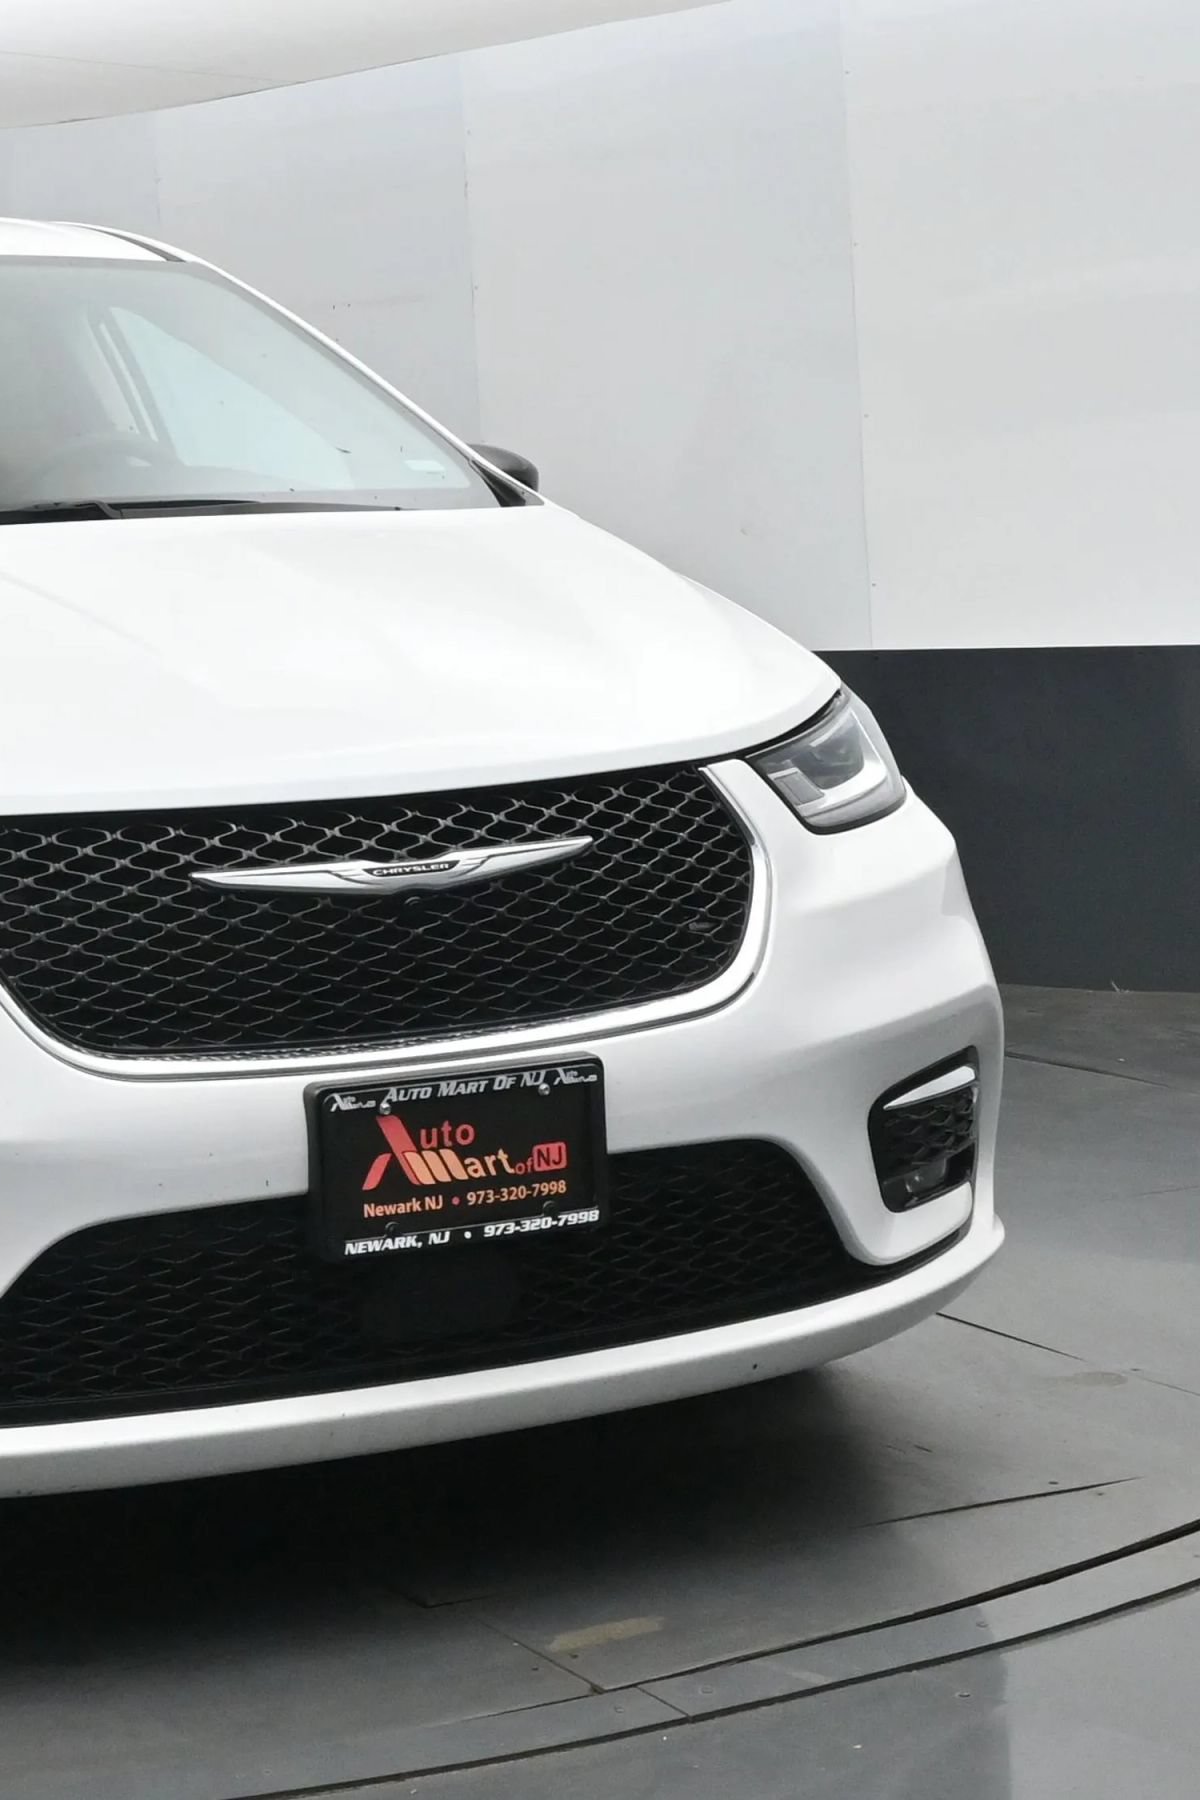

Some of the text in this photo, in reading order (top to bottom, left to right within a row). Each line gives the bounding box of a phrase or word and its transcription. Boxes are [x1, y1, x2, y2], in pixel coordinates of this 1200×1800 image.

[372, 862, 450, 876] CHRYSLER
[382, 1086, 433, 1104] AUTO
[437, 1079, 489, 1098] MART
[493, 1074, 517, 1091] OF
[520, 1069, 547, 1087] NJ
[514, 1157, 534, 1175] of
[536, 1145, 565, 1168] NJ
[363, 1179, 568, 1219] Newark NJ 973-320-7998
[344, 1209, 601, 1256] NEWARK, NJ 973-320-7998
